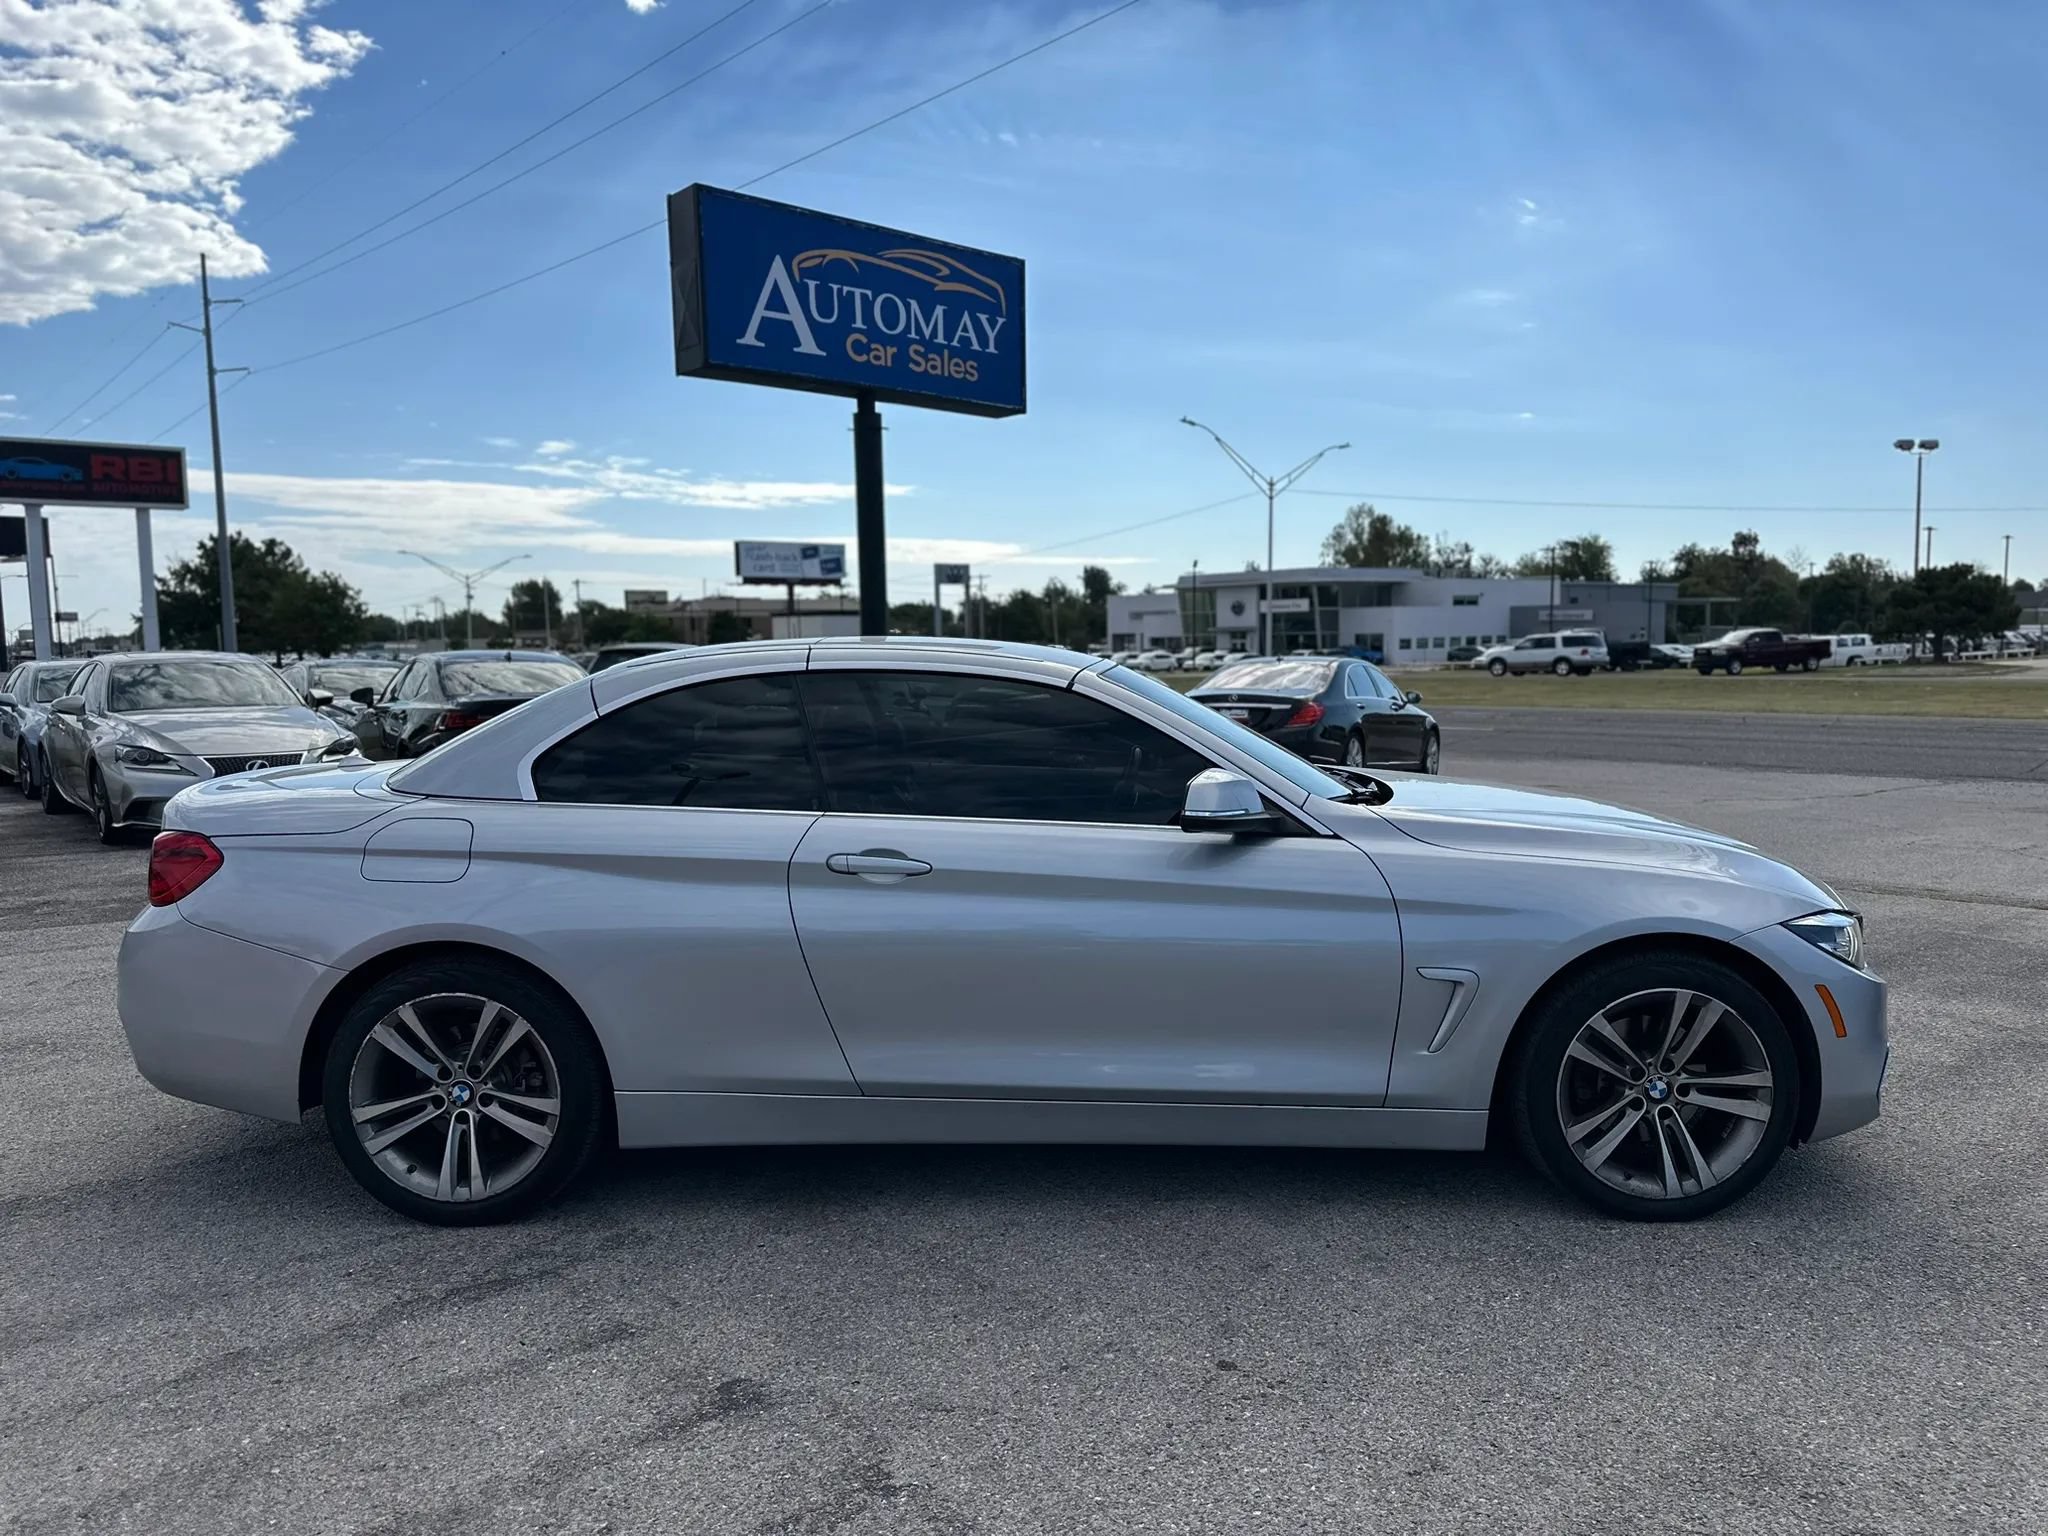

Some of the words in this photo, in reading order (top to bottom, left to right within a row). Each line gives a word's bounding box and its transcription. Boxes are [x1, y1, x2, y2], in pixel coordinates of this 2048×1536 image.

[736, 254, 1006, 356] AUTOMAY
[846, 333, 898, 367] Car
[908, 343, 979, 382] Sales
[90, 455, 180, 483] RBI
